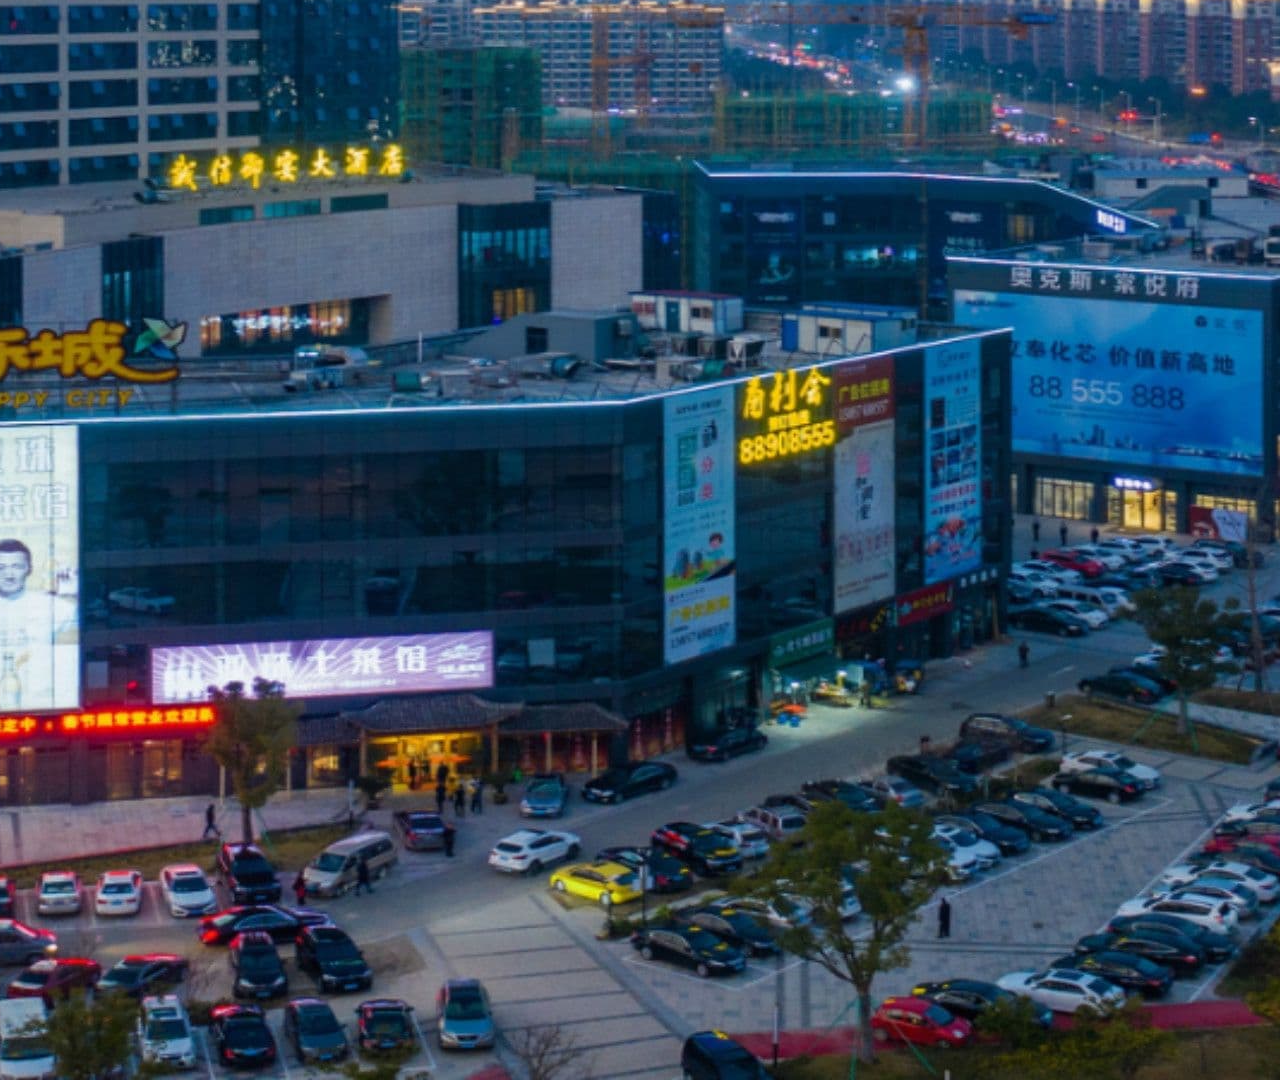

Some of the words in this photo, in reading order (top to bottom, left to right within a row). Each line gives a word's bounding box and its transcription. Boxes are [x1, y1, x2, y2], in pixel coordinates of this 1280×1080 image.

[1108, 343, 1236, 375] 价值新高地
[66, 388, 134, 408] CITY
[1029, 374, 1063, 399] 88
[1071, 378, 1124, 406] 555
[1131, 383, 1185, 411] 888
[739, 420, 836, 464] 88908555
